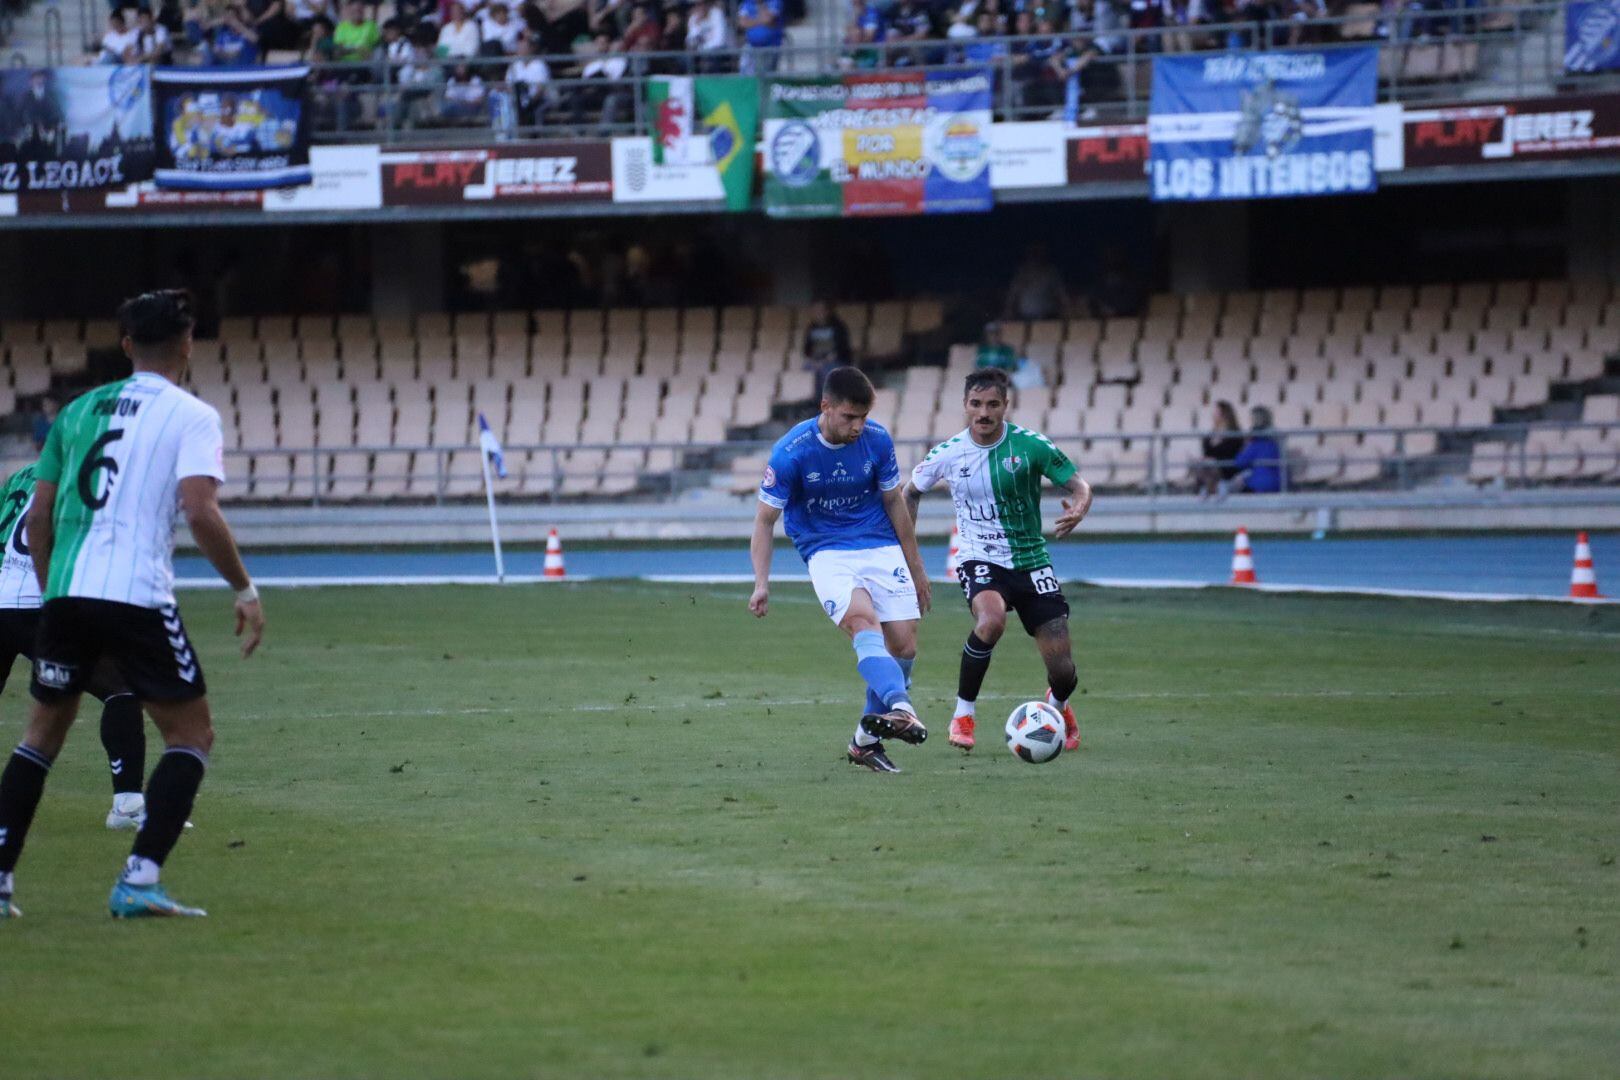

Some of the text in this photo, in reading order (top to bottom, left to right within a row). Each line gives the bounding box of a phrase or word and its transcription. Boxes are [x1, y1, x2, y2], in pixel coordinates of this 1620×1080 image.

[855, 133, 896, 154] POR
[1414, 110, 1595, 158] PLAY JEREZ
[0, 154, 124, 191] Z LEGACY
[394, 160, 478, 188] PLAY
[463, 156, 577, 200] JEREZ
[830, 158, 933, 182] EL MUNDO
[1153, 150, 1373, 200] LOS INTENSOS
[77, 428, 125, 511] 6
